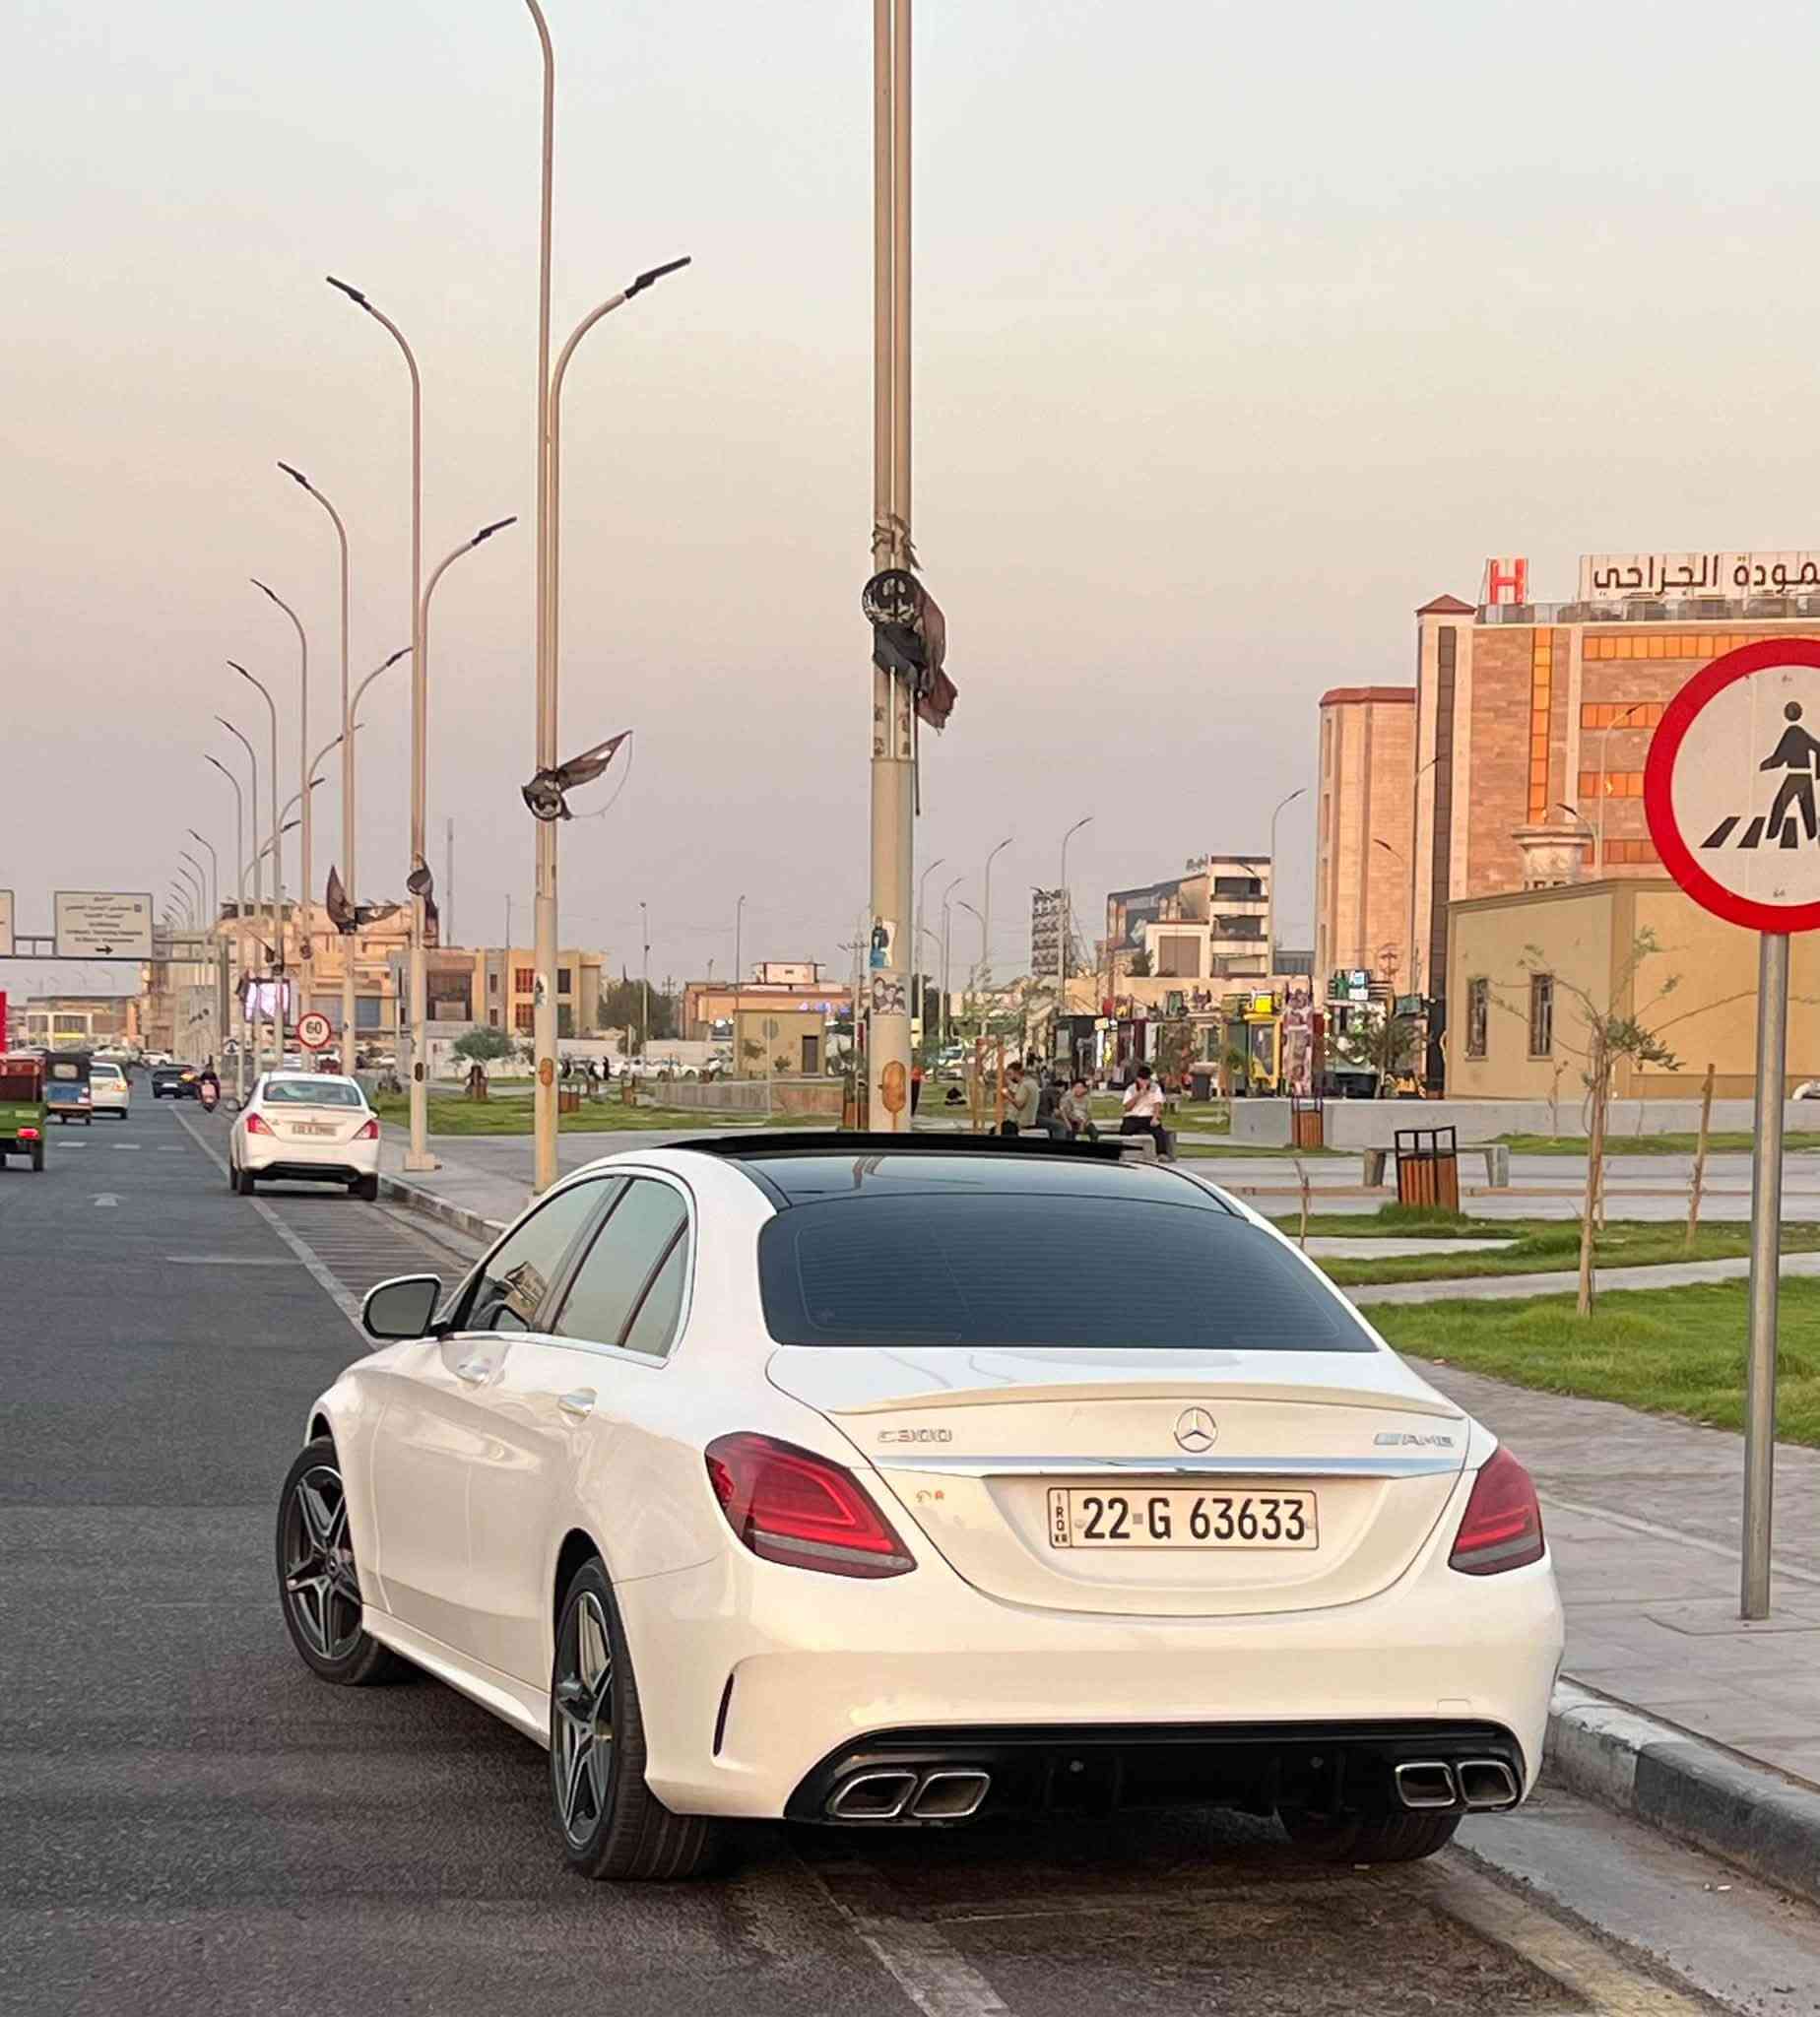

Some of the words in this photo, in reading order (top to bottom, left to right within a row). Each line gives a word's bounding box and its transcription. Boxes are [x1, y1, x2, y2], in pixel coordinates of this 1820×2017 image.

[1490, 558, 1526, 605] H
[1593, 554, 1720, 597] الجراحي
[1733, 554, 1820, 595] مودة
[306, 1020, 323, 1034] 60
[1083, 1497, 1131, 1539] 22
[1148, 1497, 1172, 1539] G
[1190, 1497, 1305, 1540] 63633
